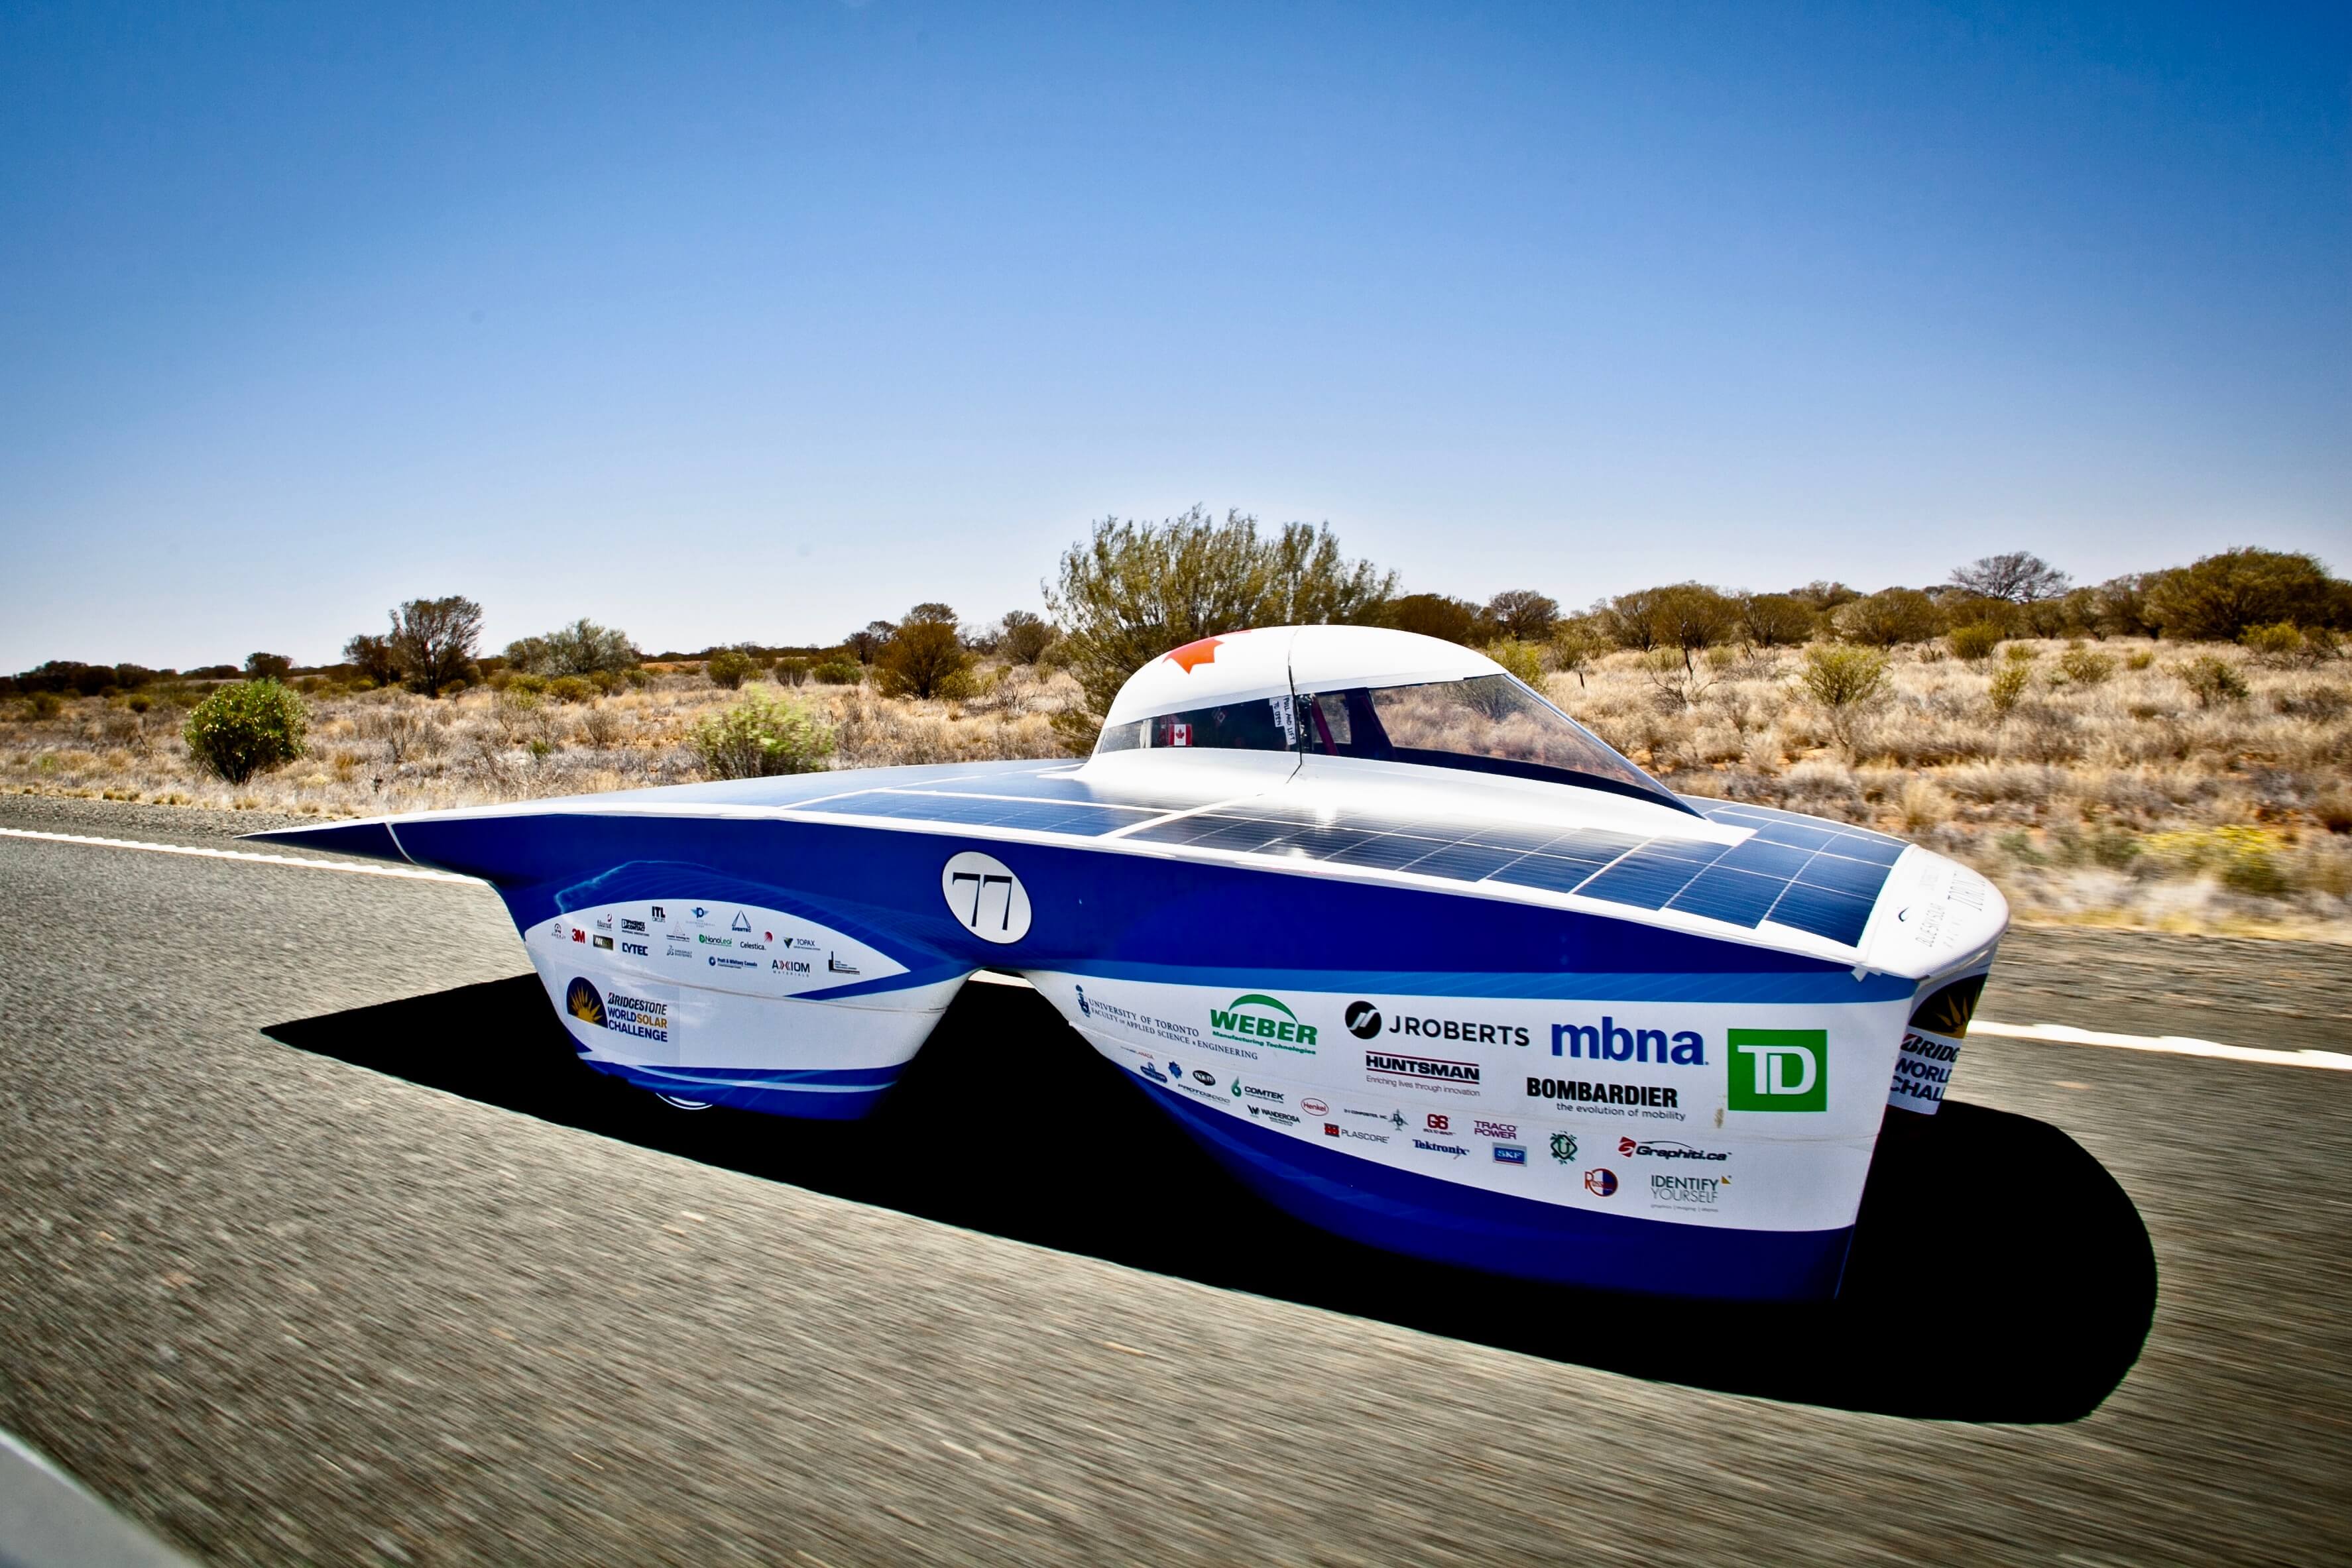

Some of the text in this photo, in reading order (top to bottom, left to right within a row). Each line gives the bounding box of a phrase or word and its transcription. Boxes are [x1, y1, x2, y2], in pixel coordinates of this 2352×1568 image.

[953, 872, 1012, 930] 77
[652, 906, 666, 919] ITL
[572, 928, 585, 944] 3M
[622, 942, 648, 956] CYTEC
[772, 959, 810, 974] AXIOM
[607, 991, 668, 1015] BRIDGESTONE
[1088, 998, 1199, 1037] UNIVERSITY OF TORONTO
[609, 1019, 668, 1043] CHALLENGE
[1091, 1007, 1118, 1023] FACULTY
[1127, 1021, 1155, 1035] APPLIED
[1157, 1029, 1191, 1045] SCIENCE
[1197, 1040, 1258, 1060] ENGINEERING
[1210, 1009, 1318, 1046] WEBER
[1212, 1031, 1317, 1055] Manufacturing Technologies
[1366, 1054, 1480, 1081] HUNTSMAN
[1737, 1044, 1817, 1095] TD
[1244, 1086, 1285, 1100] COMTEK
[1366, 1075, 1480, 1097] Enriching lives through innovation
[1527, 1077, 1678, 1109] BOMBARDIER
[1303, 1101, 1326, 1113] Henkel
[1557, 1103, 1686, 1122] the evolution of mobility
[1261, 1108, 1301, 1124] WANDEROSA
[1474, 1120, 1517, 1133] TRACO
[1474, 1128, 1517, 1140] POWER
[1341, 1129, 1388, 1144] PLASCORE
[1411, 1139, 1468, 1157] Tektronix
[1498, 1149, 1522, 1158] SKF
[1636, 1145, 1728, 1161] Graphiti.ca
[1651, 1175, 1719, 1192] IDENTIFY
[1651, 1188, 1719, 1204] YOURSELF
